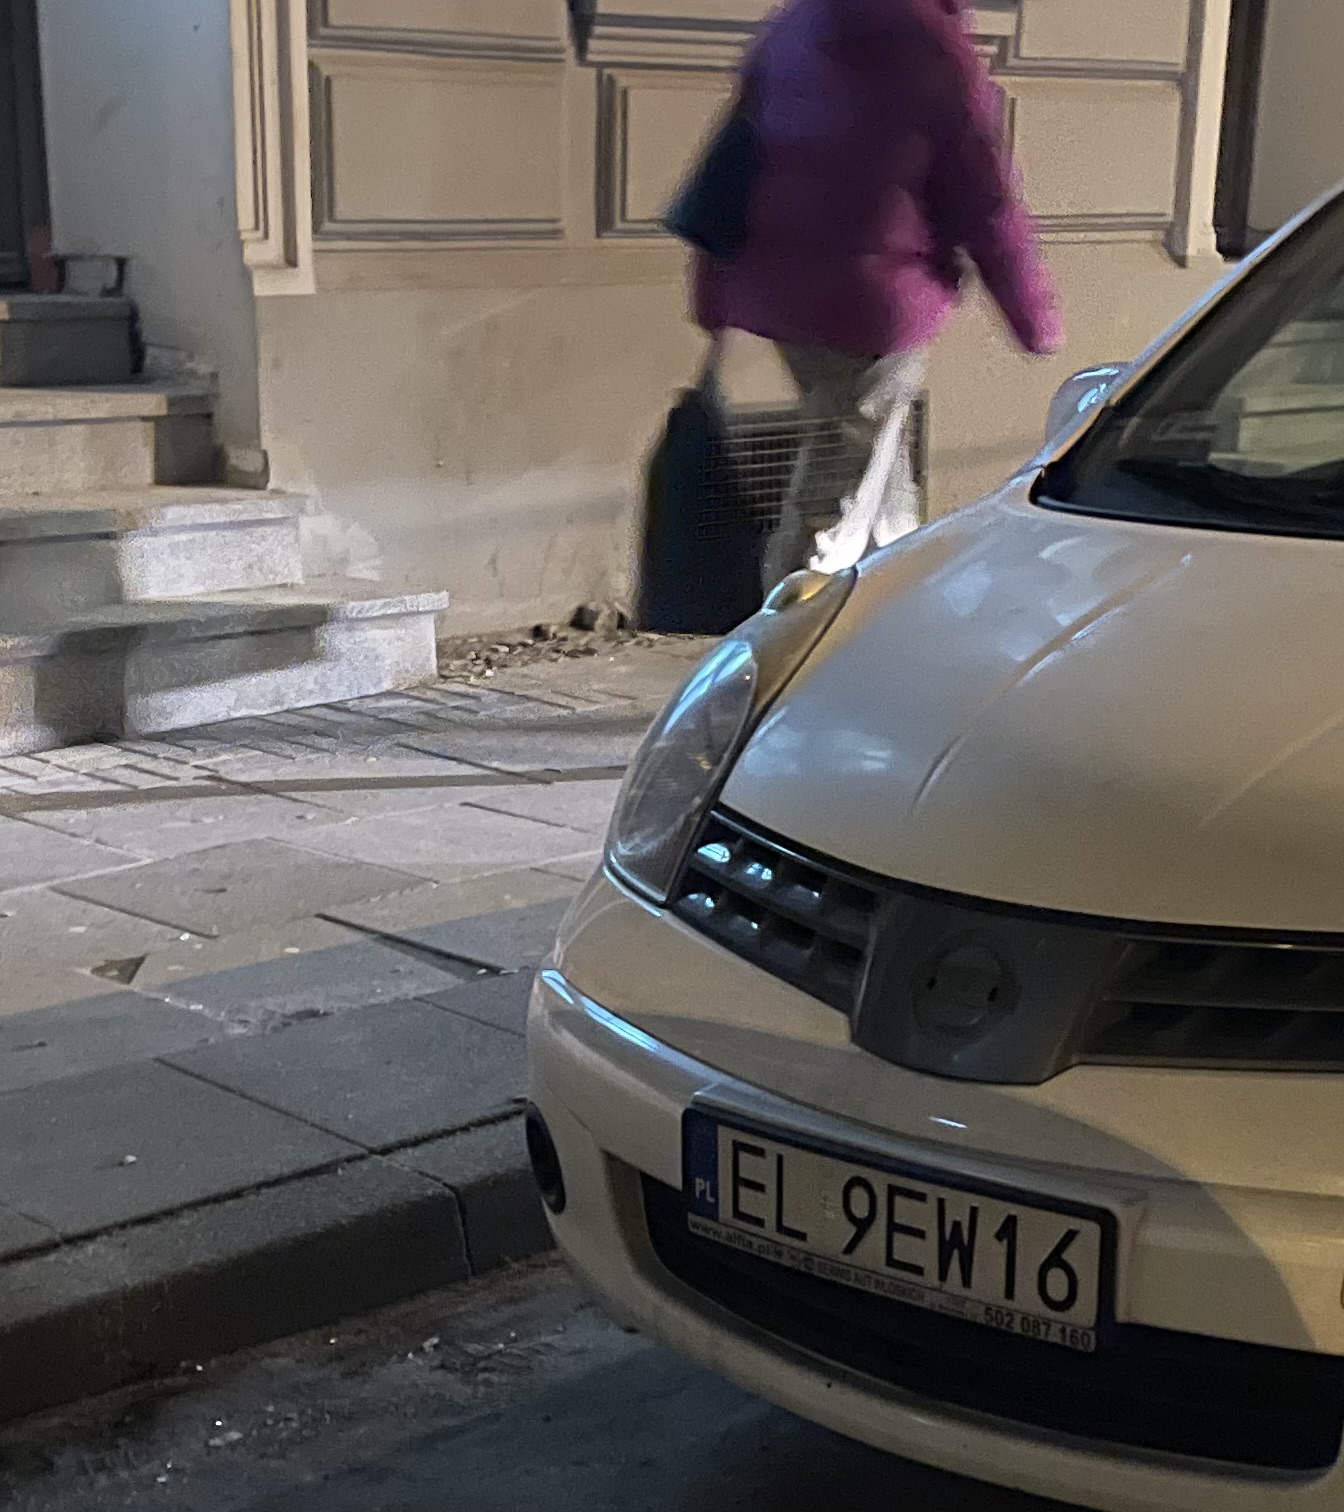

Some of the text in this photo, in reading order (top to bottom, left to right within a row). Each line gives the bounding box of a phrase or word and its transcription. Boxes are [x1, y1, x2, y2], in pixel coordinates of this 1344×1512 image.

[695, 1177, 715, 1204] PL
[731, 1139, 1080, 1313] EL 9EW16
[983, 1306, 1015, 1330] 502
